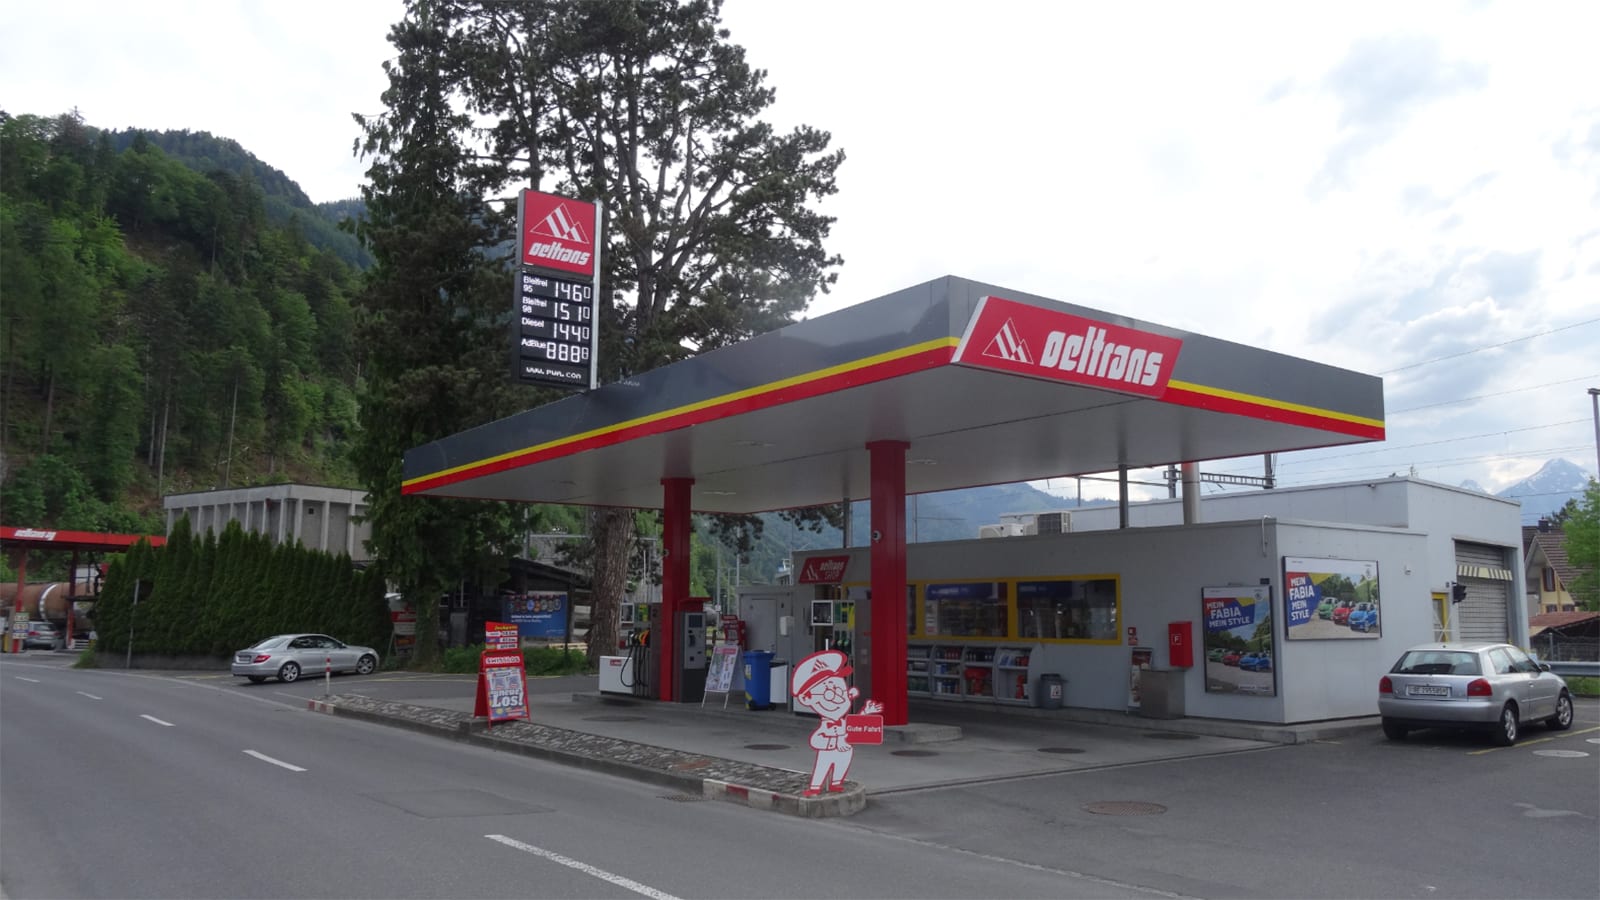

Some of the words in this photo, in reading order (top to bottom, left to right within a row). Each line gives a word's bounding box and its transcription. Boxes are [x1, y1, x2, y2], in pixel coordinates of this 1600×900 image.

[528, 241, 591, 266] oeltrans
[523, 276, 548, 288] Bleifrei
[523, 284, 533, 293] 95
[522, 296, 547, 308] Bleifrei
[521, 317, 545, 328] Diesel
[521, 338, 547, 349] AdBlue
[1039, 325, 1164, 387] oeltrans
[1291, 576, 1306, 587] MEIN
[1289, 585, 1315, 600] FABIA
[1206, 601, 1225, 610] MEIN
[1292, 600, 1307, 611] MEIN
[1210, 607, 1242, 620] FABIA
[1291, 609, 1309, 621] STYLE
[1208, 619, 1227, 629] MEIN
[1228, 616, 1250, 626] STYLE
[863, 725, 881, 733] Fahrt
